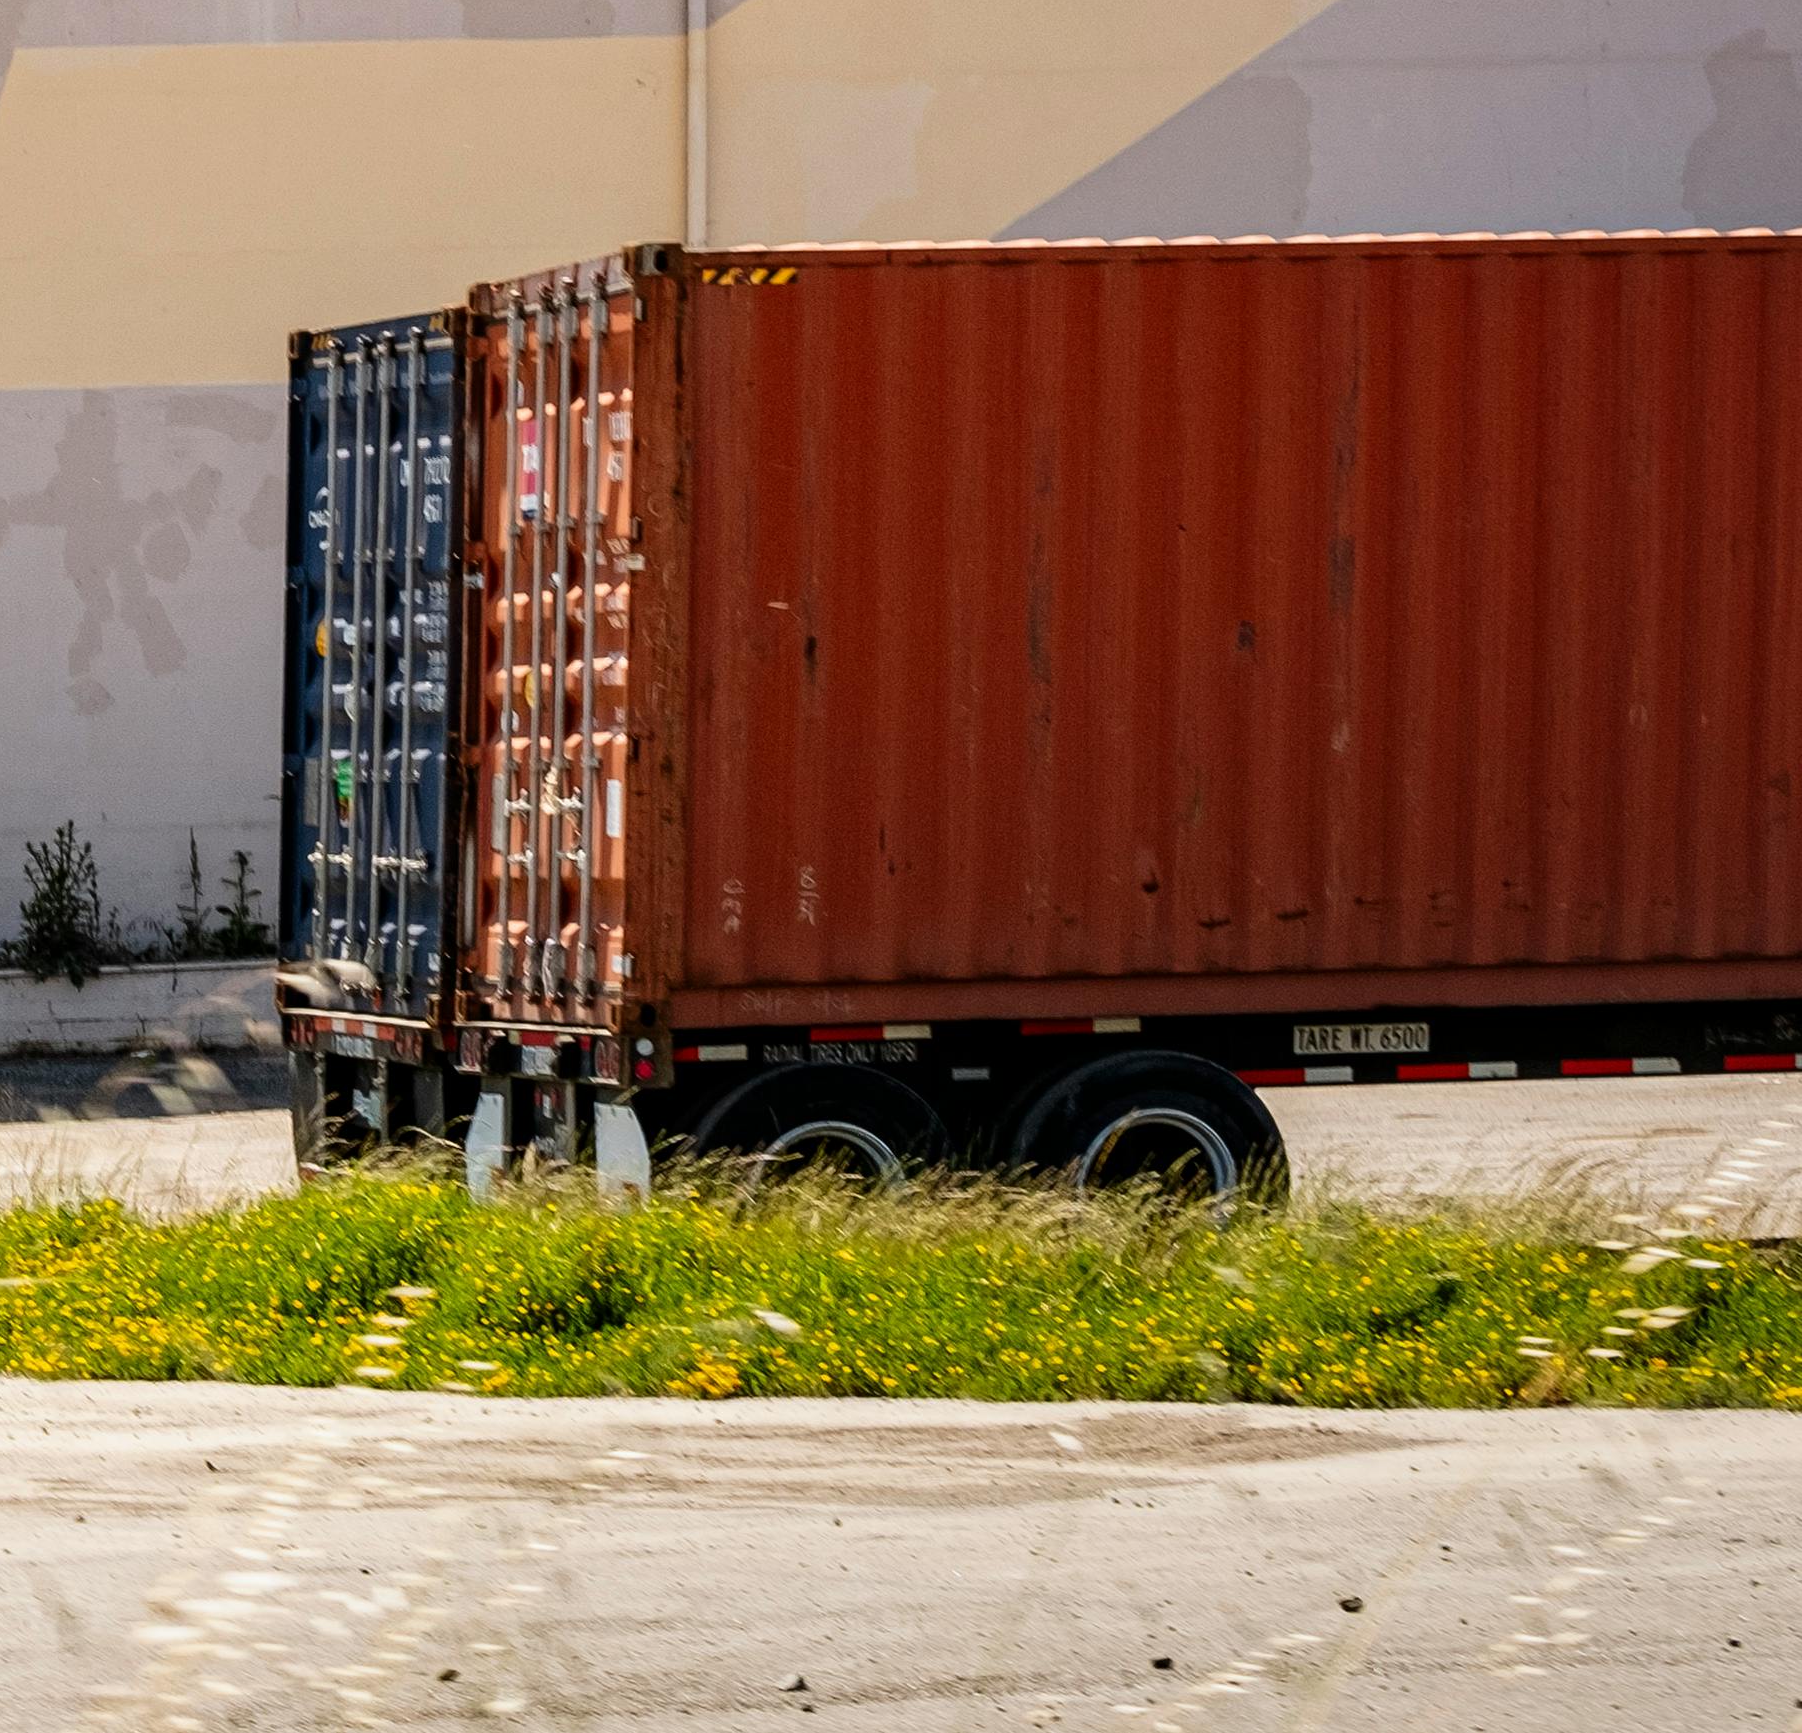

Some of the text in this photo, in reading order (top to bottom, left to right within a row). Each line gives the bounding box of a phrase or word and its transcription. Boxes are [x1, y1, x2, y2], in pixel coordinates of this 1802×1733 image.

[1298, 1025, 1426, 1051] TARE WT. 6500
[763, 1044, 804, 1063] RADIAL
[809, 1043, 844, 1064] TIRES
[845, 1042, 876, 1064] ONLY
